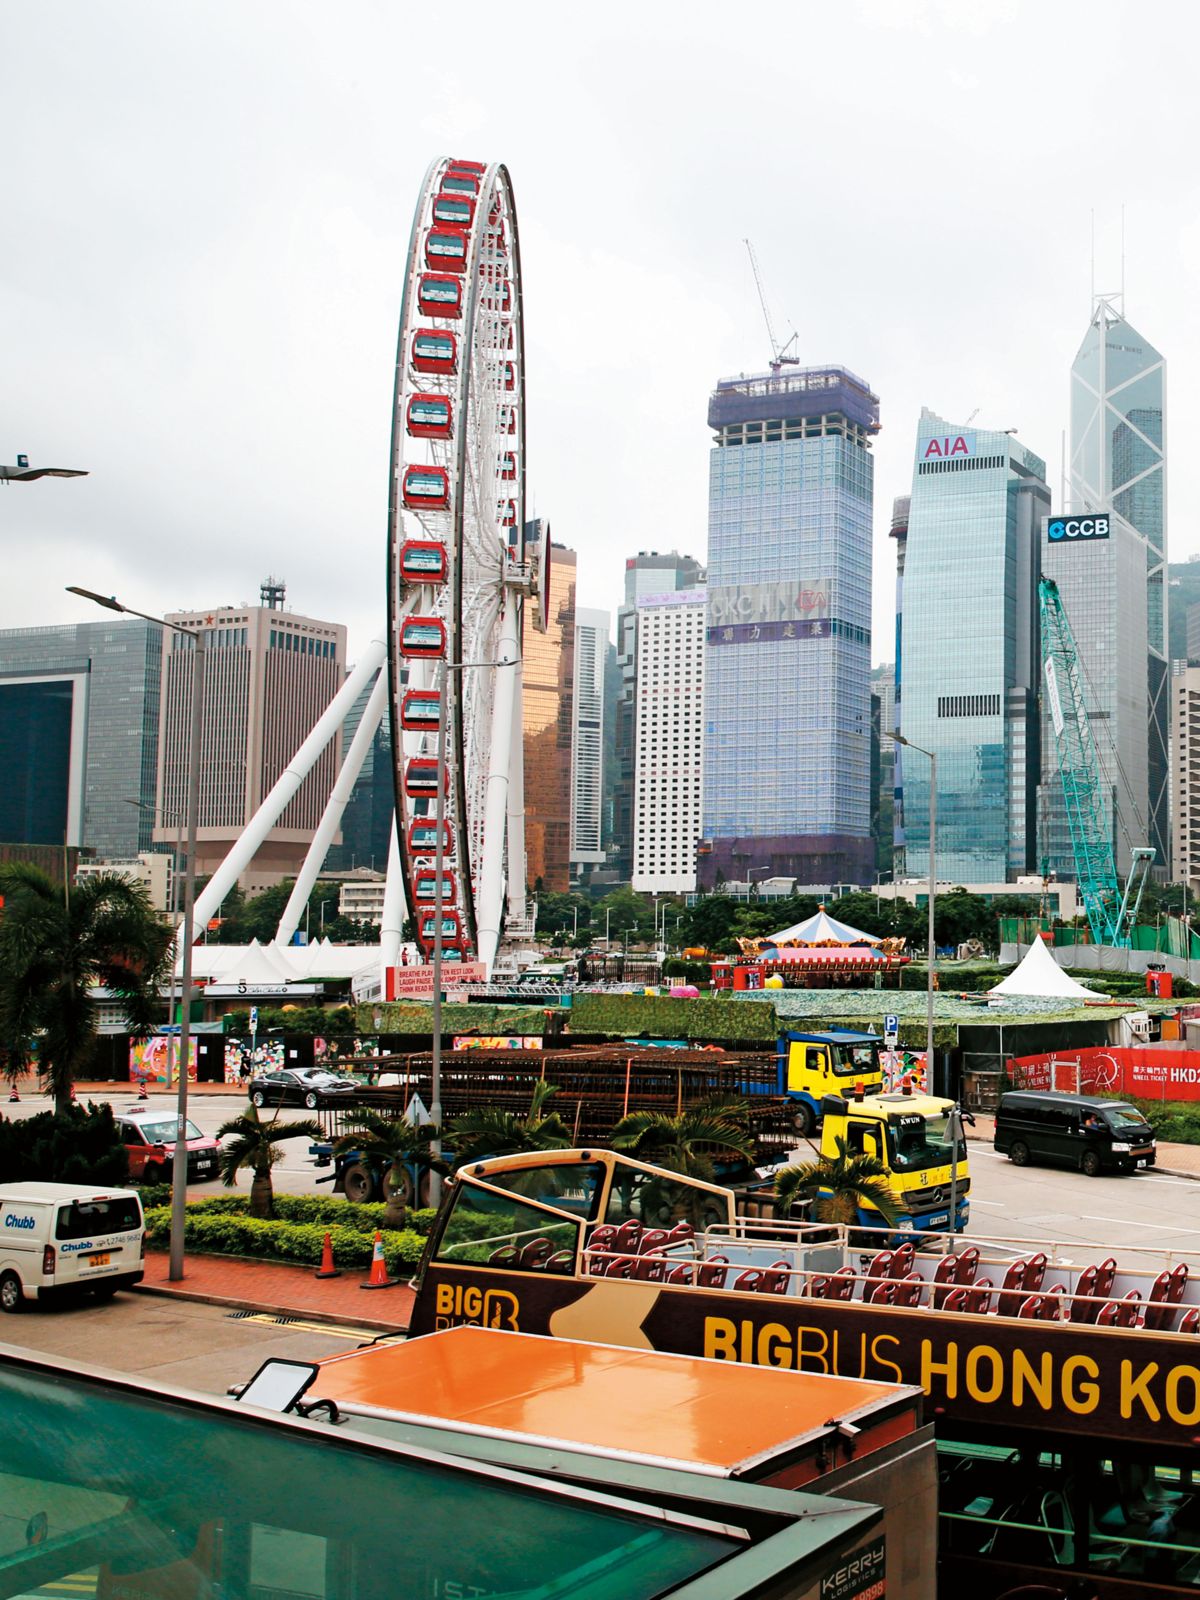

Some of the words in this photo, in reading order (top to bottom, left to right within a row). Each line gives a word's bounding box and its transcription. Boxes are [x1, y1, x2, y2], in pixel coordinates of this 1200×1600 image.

[925, 436, 969, 458] AIA
[1065, 519, 1108, 537] CCB
[400, 970, 420, 978] BREATHE
[886, 1016, 896, 1030] P
[900, 1117, 920, 1125] KWUN
[5, 1214, 35, 1229] Chubb
[61, 1241, 93, 1252] Chubb
[436, 1284, 482, 1317] BIG
[921, 1339, 1100, 1415] HONG
[822, 1545, 884, 1594] KERRY
[831, 1567, 876, 1599] LOGISTICS
